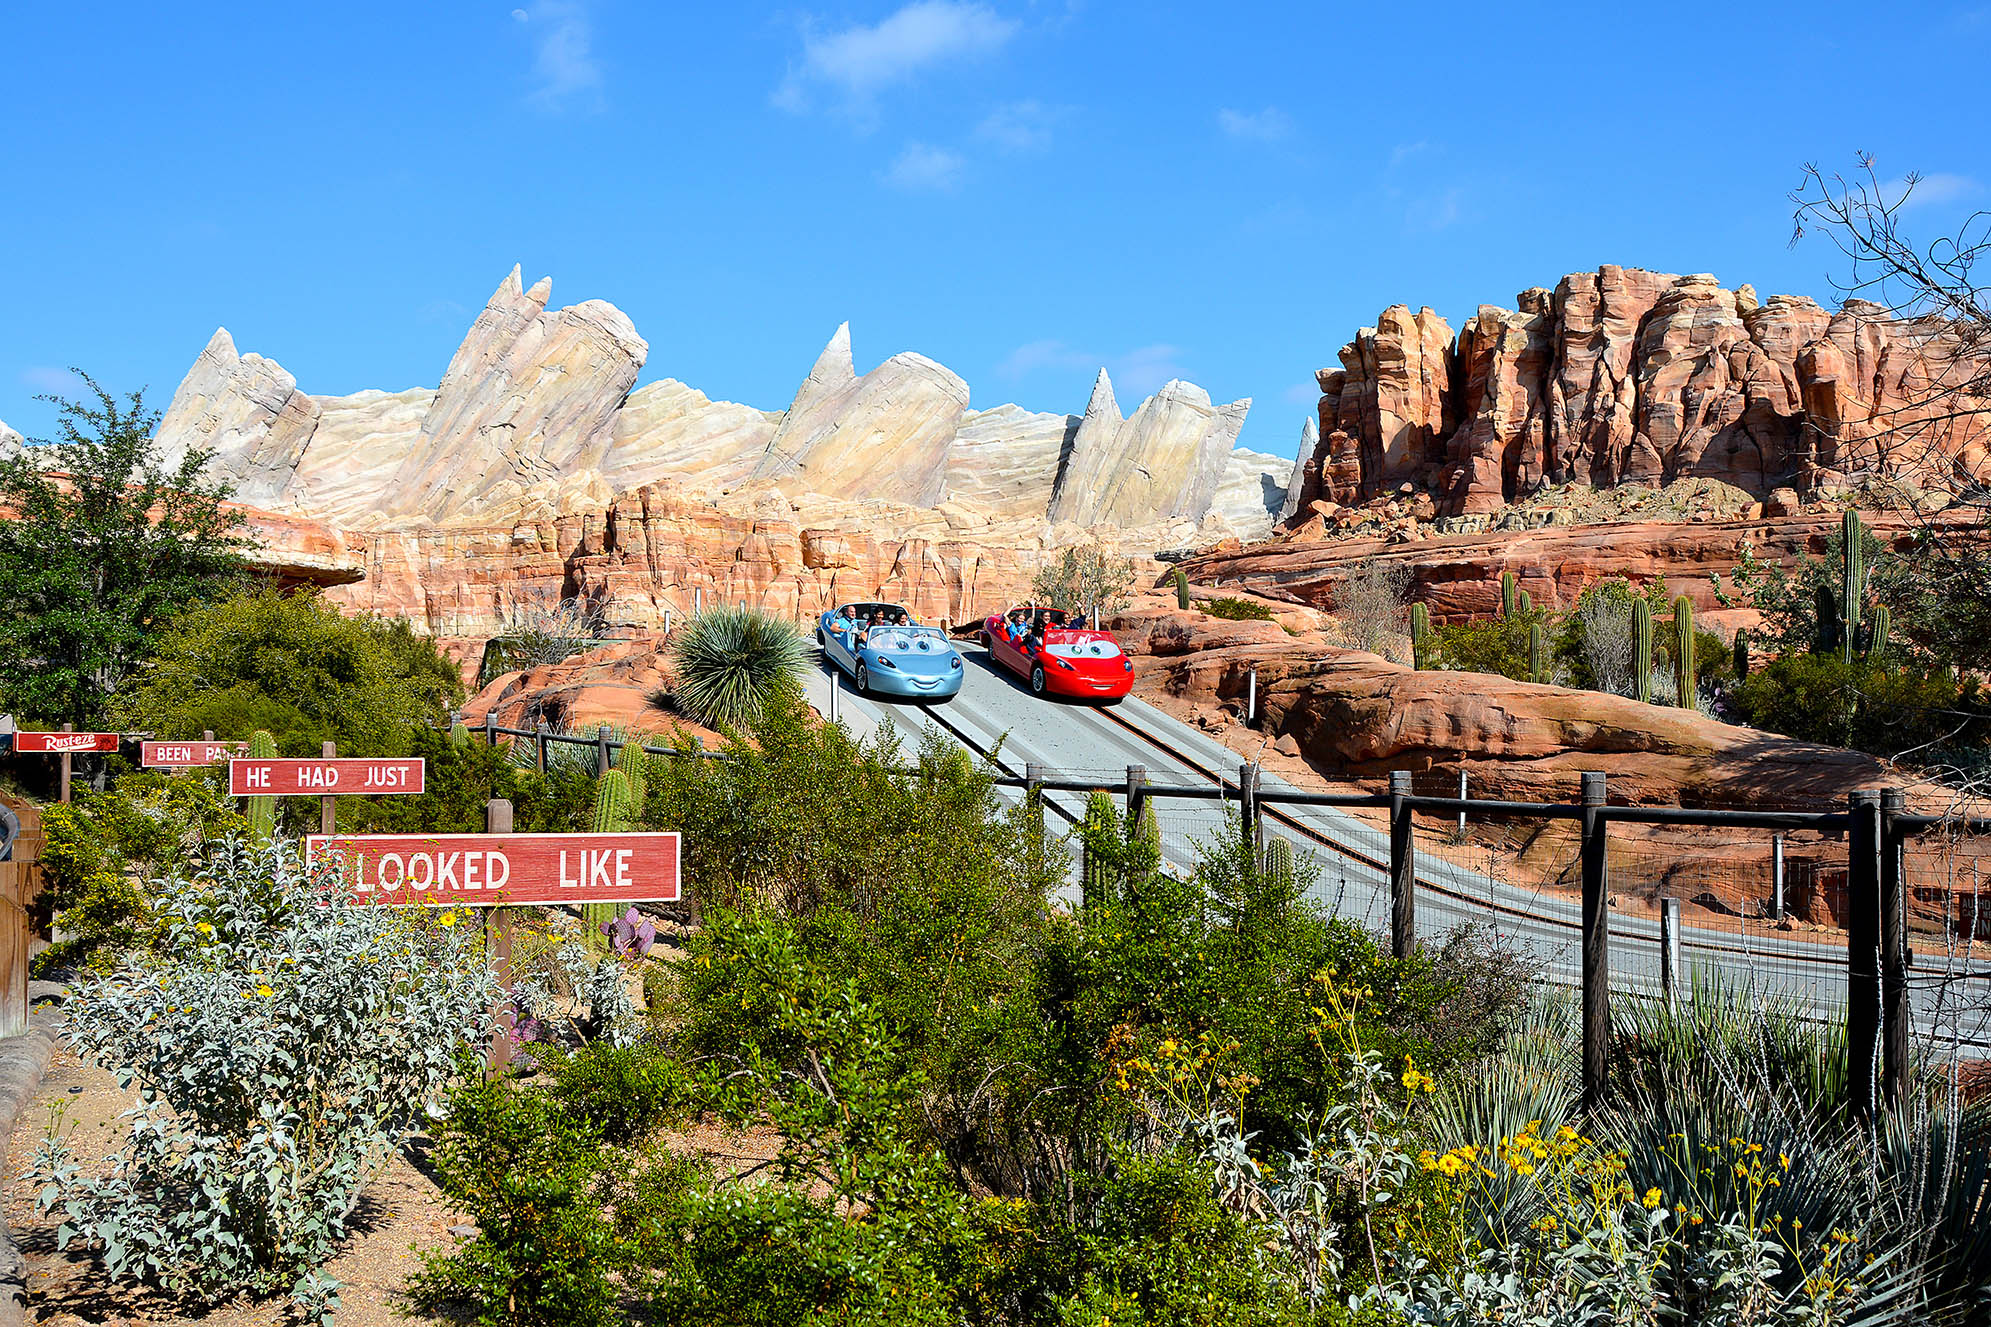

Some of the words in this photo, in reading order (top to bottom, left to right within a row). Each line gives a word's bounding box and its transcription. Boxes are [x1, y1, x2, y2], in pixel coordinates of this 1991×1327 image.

[157, 747, 191, 761] BEEN
[246, 767, 272, 788] HE
[298, 767, 339, 787] HAD
[364, 766, 409, 787] JUST
[356, 852, 510, 892] LOOKED
[559, 850, 633, 888] LIKE
